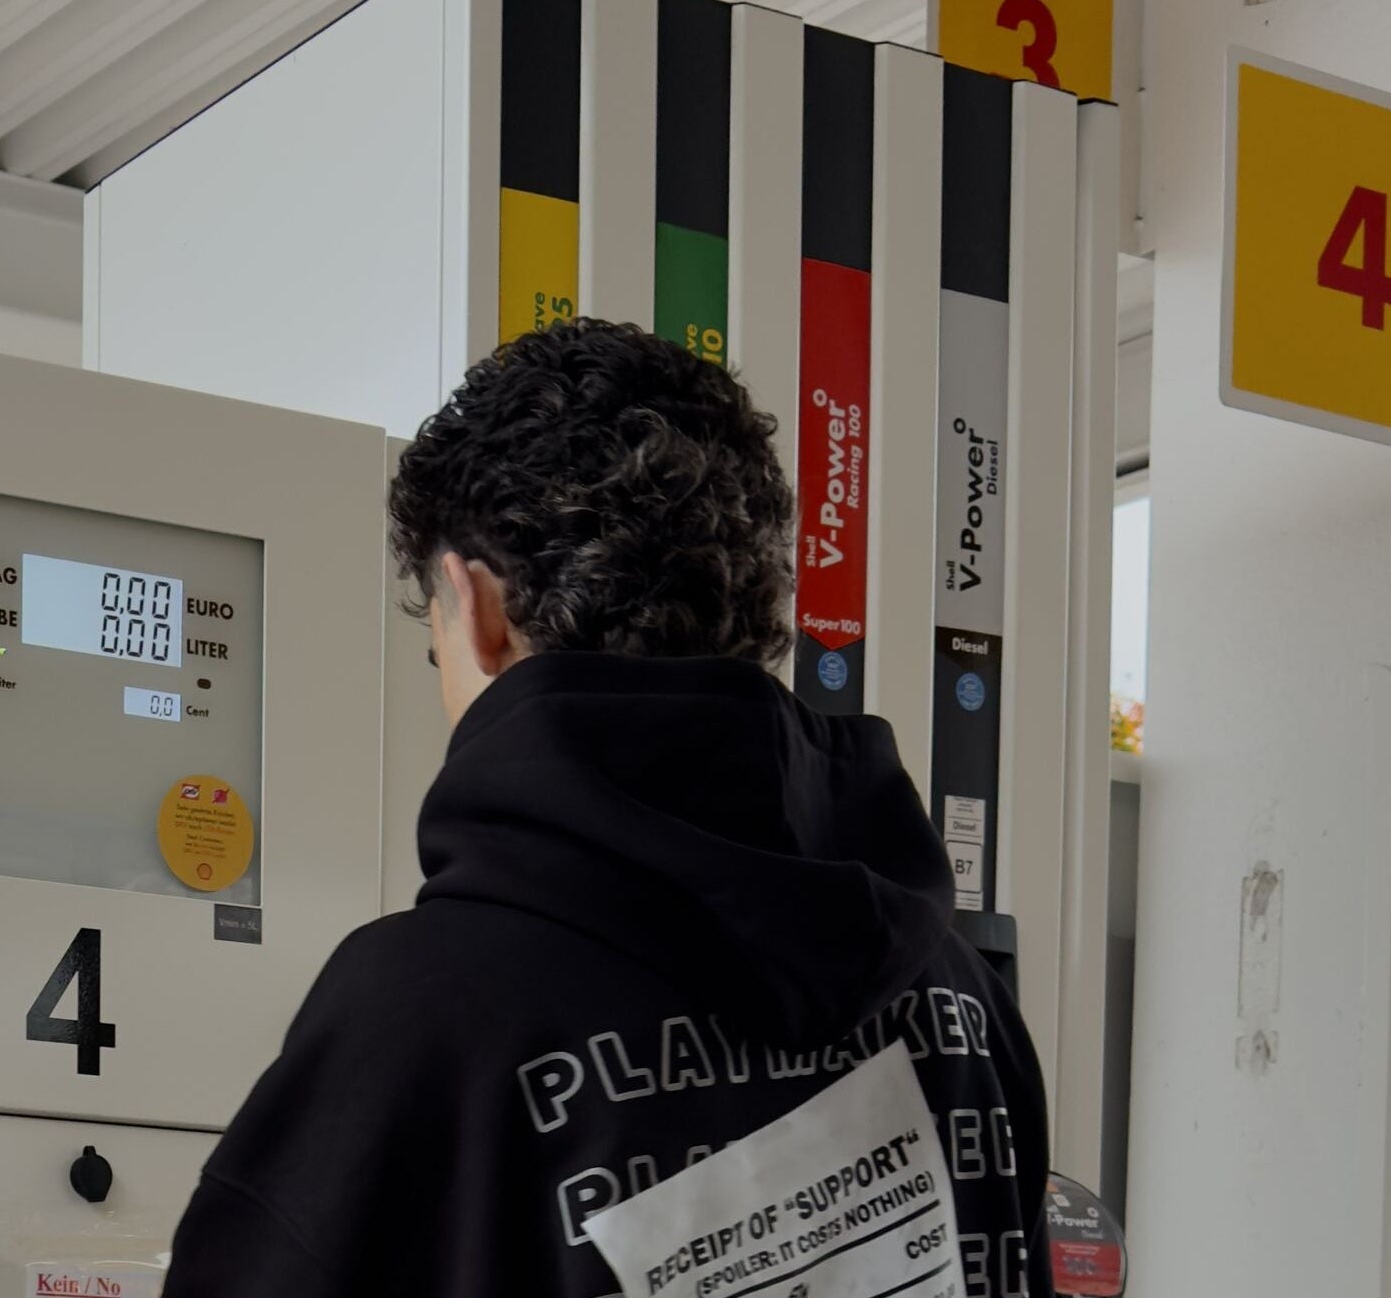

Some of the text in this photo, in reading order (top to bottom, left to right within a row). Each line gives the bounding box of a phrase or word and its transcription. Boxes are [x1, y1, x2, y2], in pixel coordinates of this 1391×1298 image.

[989, 0, 1061, 89] 3
[1317, 185, 1391, 331] 4
[847, 404, 863, 509] Racing 100
[985, 439, 999, 496] Diesel
[819, 399, 847, 569] V-Power
[960, 428, 985, 592] V-Power
[101, 572, 171, 621] 0,00
[946, 560, 957, 591] Shell
[186, 597, 235, 621] EURO
[100, 614, 171, 662] 0,00
[186, 638, 229, 660] LITER
[951, 636, 989, 656] Diesel
[150, 694, 174, 718] 0,0
[186, 704, 210, 719] Cent
[955, 858, 974, 876] B7
[25, 927, 117, 1077] 4
[782, 1241, 796, 1264] IT
[797, 1217, 843, 1255] COSTS
[844, 1170, 936, 1229] NOTHING)
[645, 1219, 744, 1297] RECEIPT
[750, 1204, 778, 1241] OF
[905, 1222, 949, 1261] COST
[36, 1273, 80, 1294] Kein
[96, 1276, 121, 1297] No
